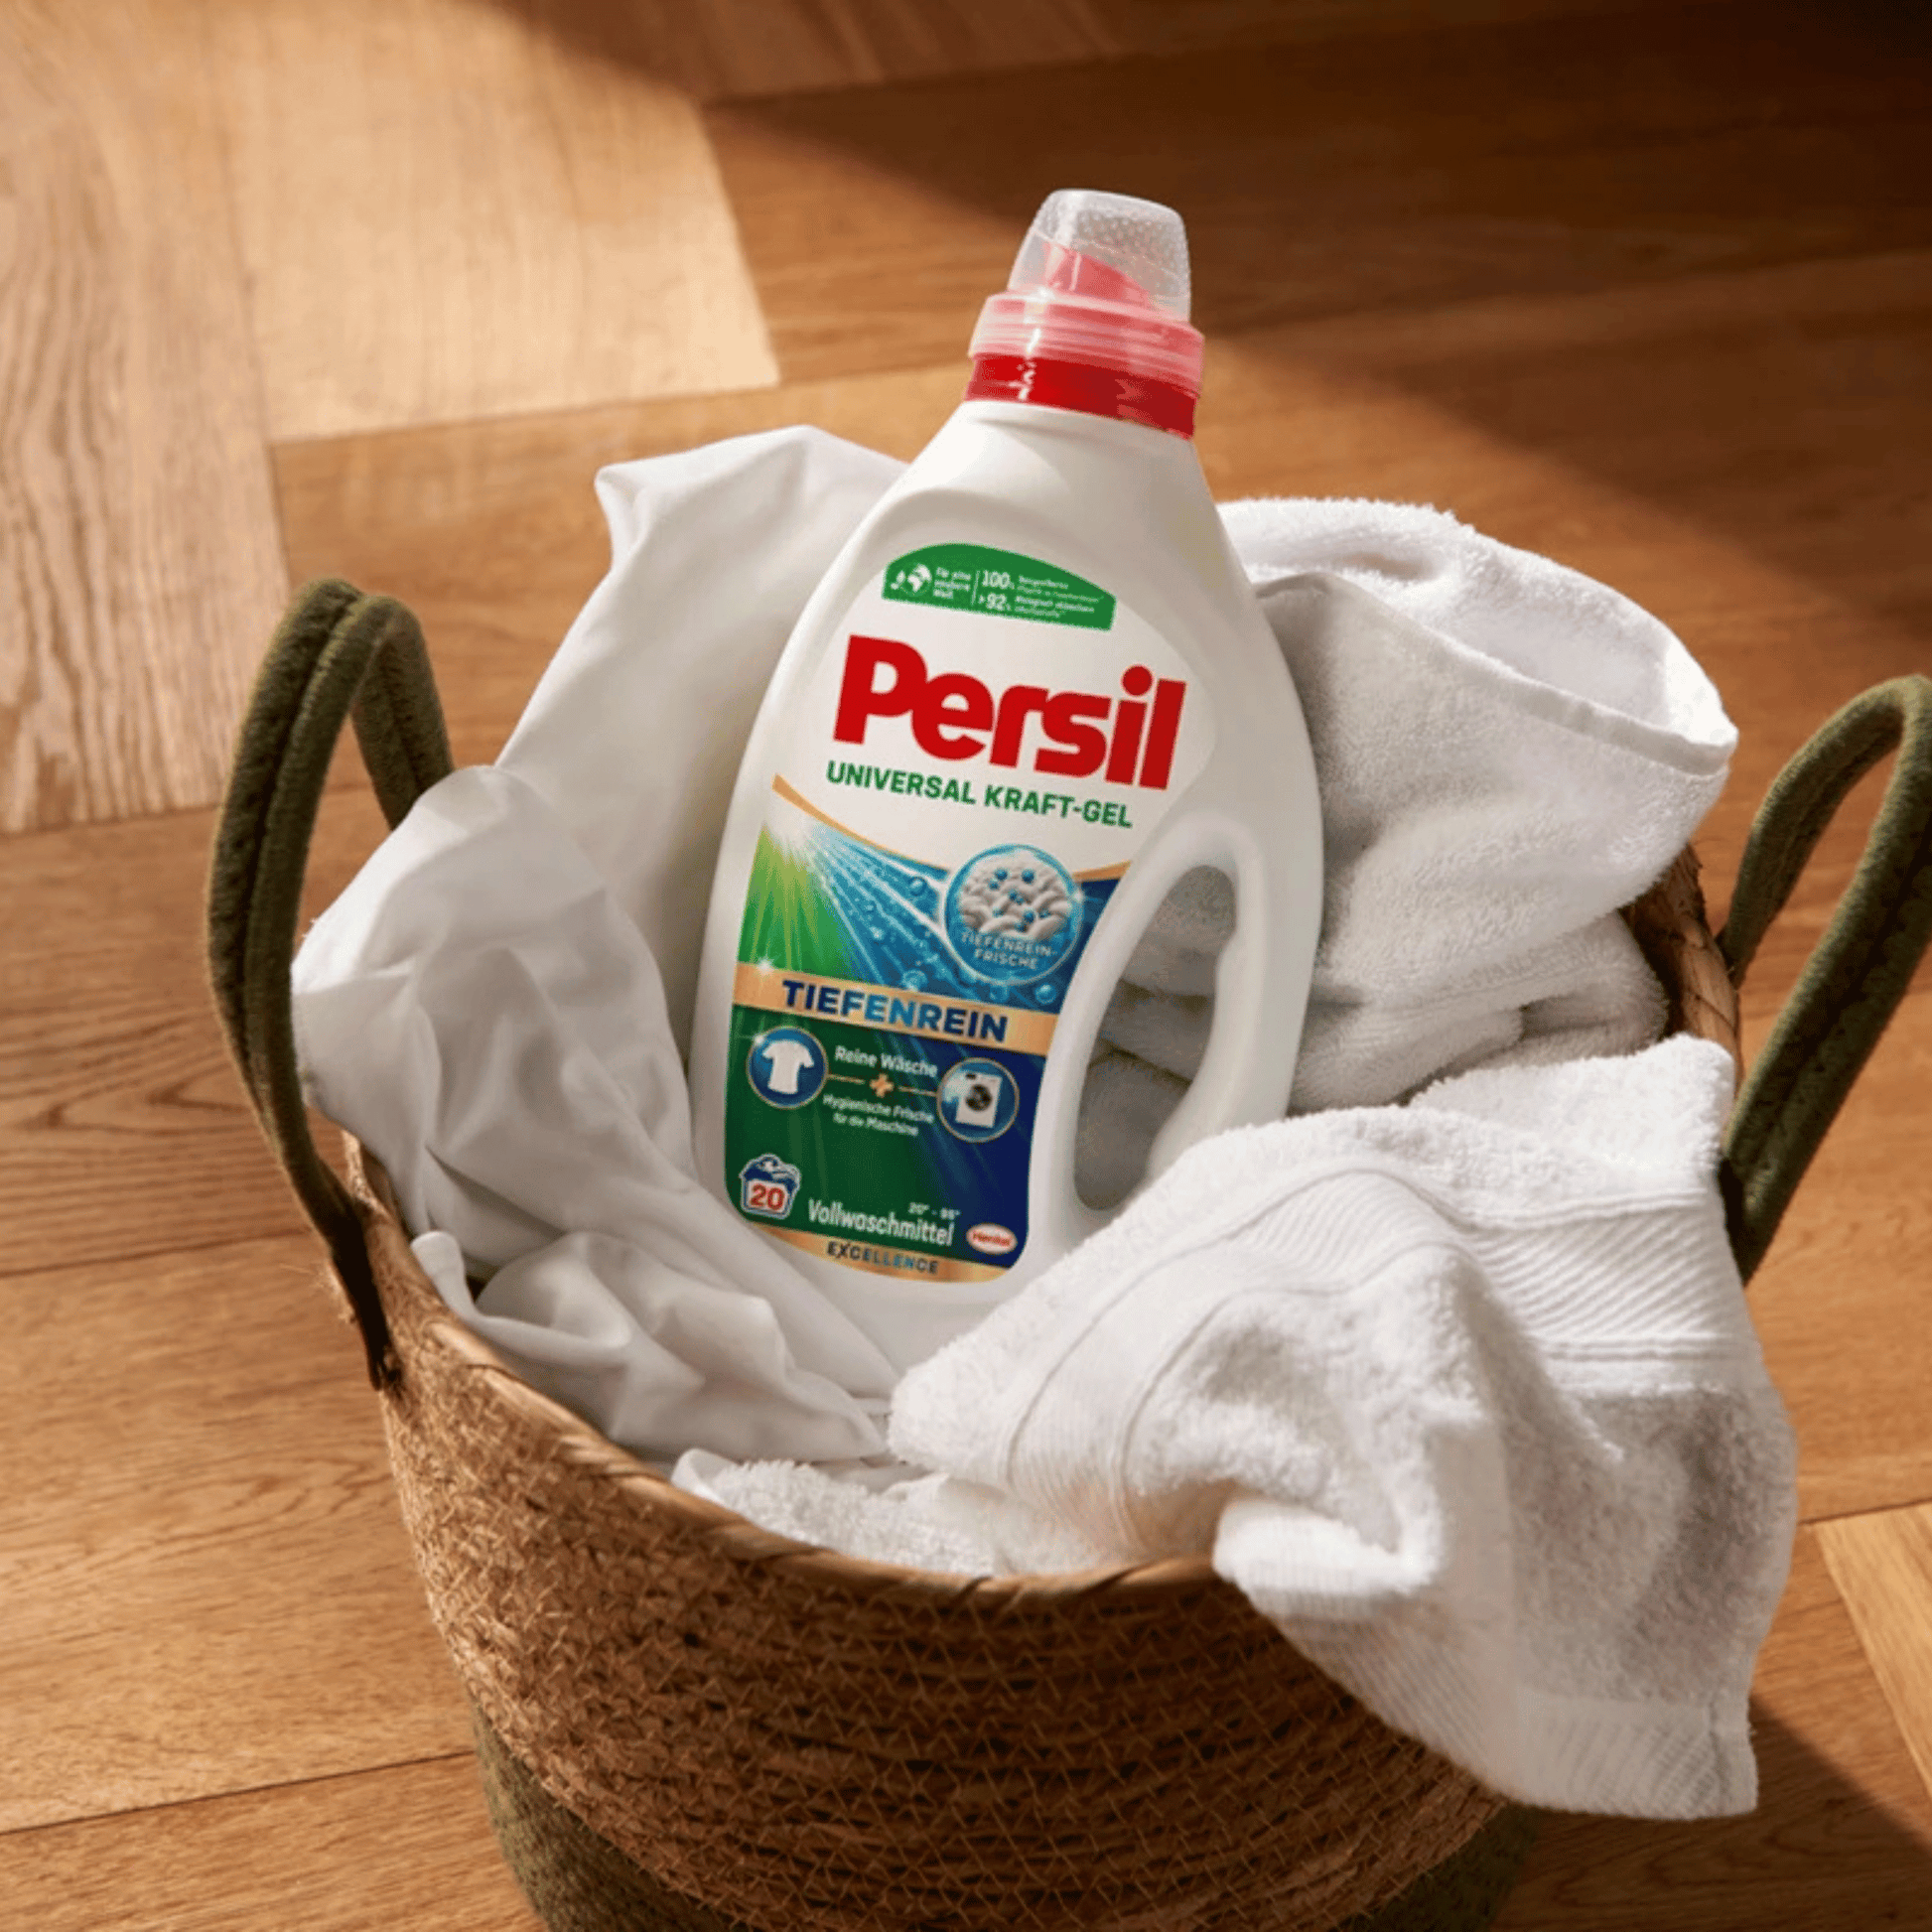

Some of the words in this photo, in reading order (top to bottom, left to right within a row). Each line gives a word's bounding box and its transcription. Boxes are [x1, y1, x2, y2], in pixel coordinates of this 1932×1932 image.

[833, 634, 1186, 790] Persil
[826, 760, 976, 805] UNIVERSAL
[984, 784, 1133, 829] KRAFT-GEL
[973, 947, 1038, 970] FRISCHE
[782, 979, 1009, 1042] TIEFENREIN
[834, 1044, 878, 1068] Reine
[881, 1050, 938, 1078] Wäsche
[822, 1094, 892, 1117] Hygienische
[893, 1105, 935, 1124] Frische
[849, 1114, 864, 1128] die
[866, 1117, 919, 1137] Maschine
[751, 1183, 785, 1211] 20
[808, 1197, 955, 1246] Vollwaschmittel
[827, 1240, 939, 1275] EXCELLENCE
